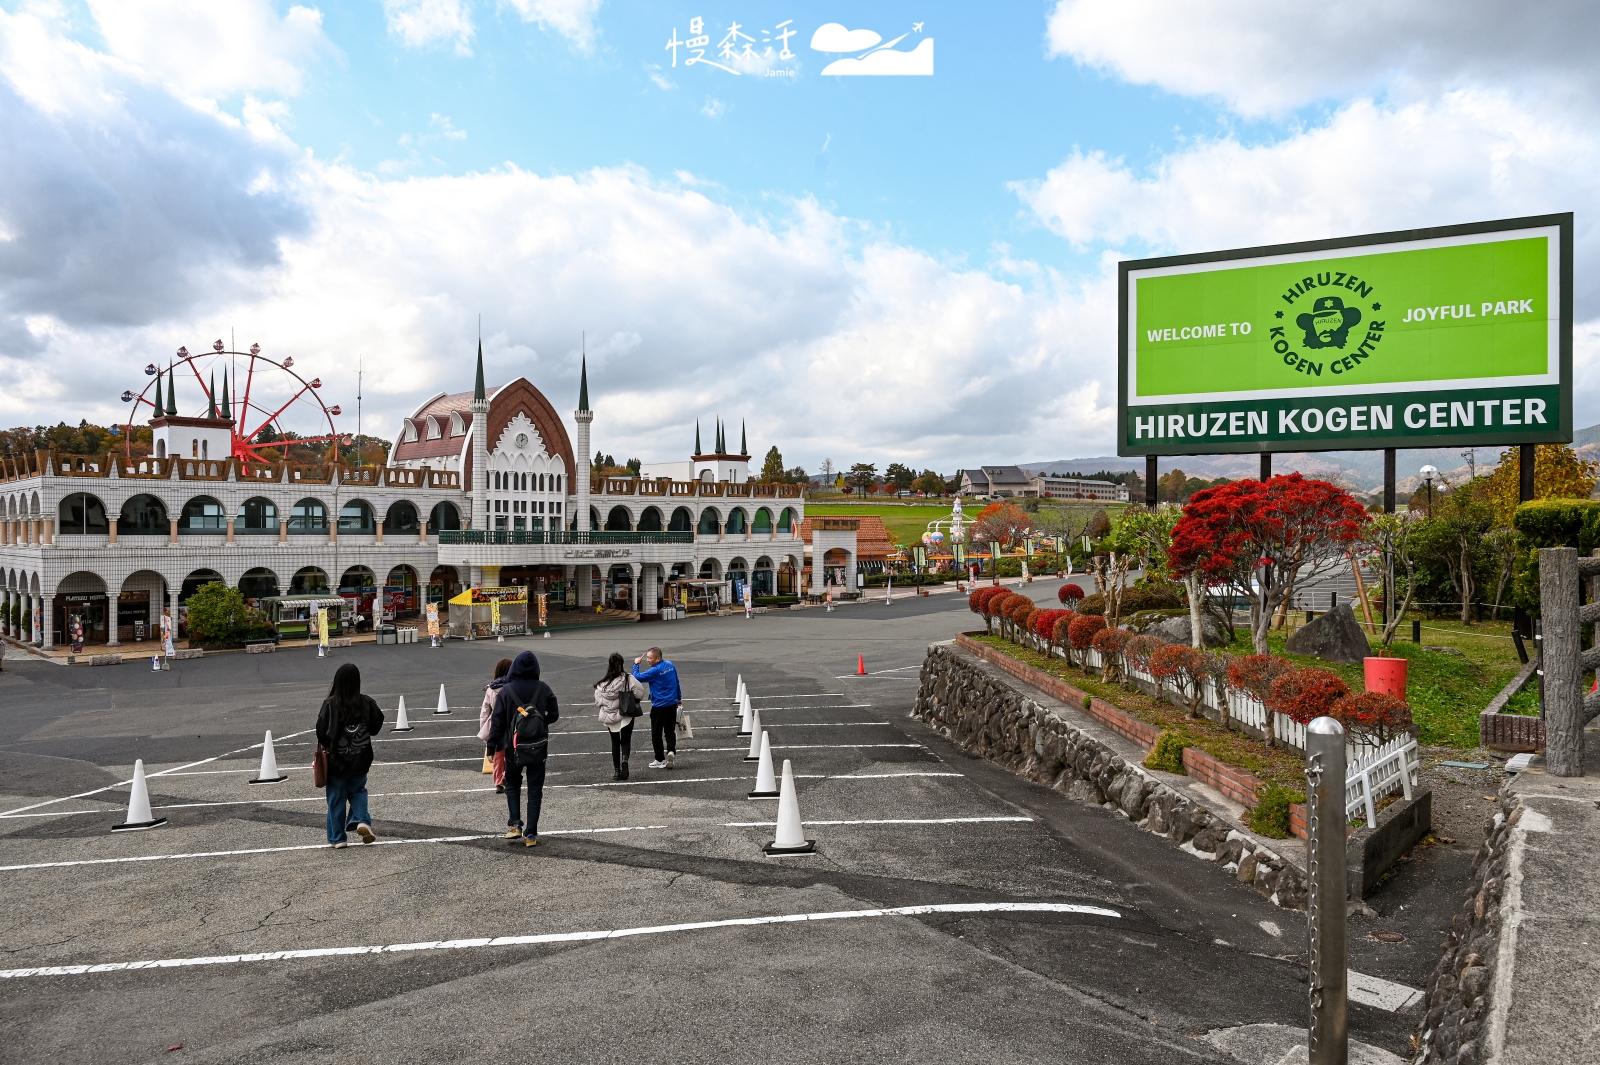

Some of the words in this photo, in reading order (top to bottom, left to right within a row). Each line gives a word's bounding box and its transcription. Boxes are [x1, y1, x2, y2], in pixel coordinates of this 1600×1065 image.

[1282, 272, 1373, 305] HIRUZEN
[1403, 304, 1476, 322] JOYFUL
[1481, 299, 1533, 316] PARK
[1147, 324, 1226, 342] WELCOME
[1230, 322, 1252, 335] TO
[1270, 326, 1323, 376] KOGEN
[1330, 320, 1386, 374] CENTER
[1135, 411, 1268, 439] HIRUZEN
[1278, 404, 1393, 434] KOGEN
[1403, 398, 1547, 429] CENTER
